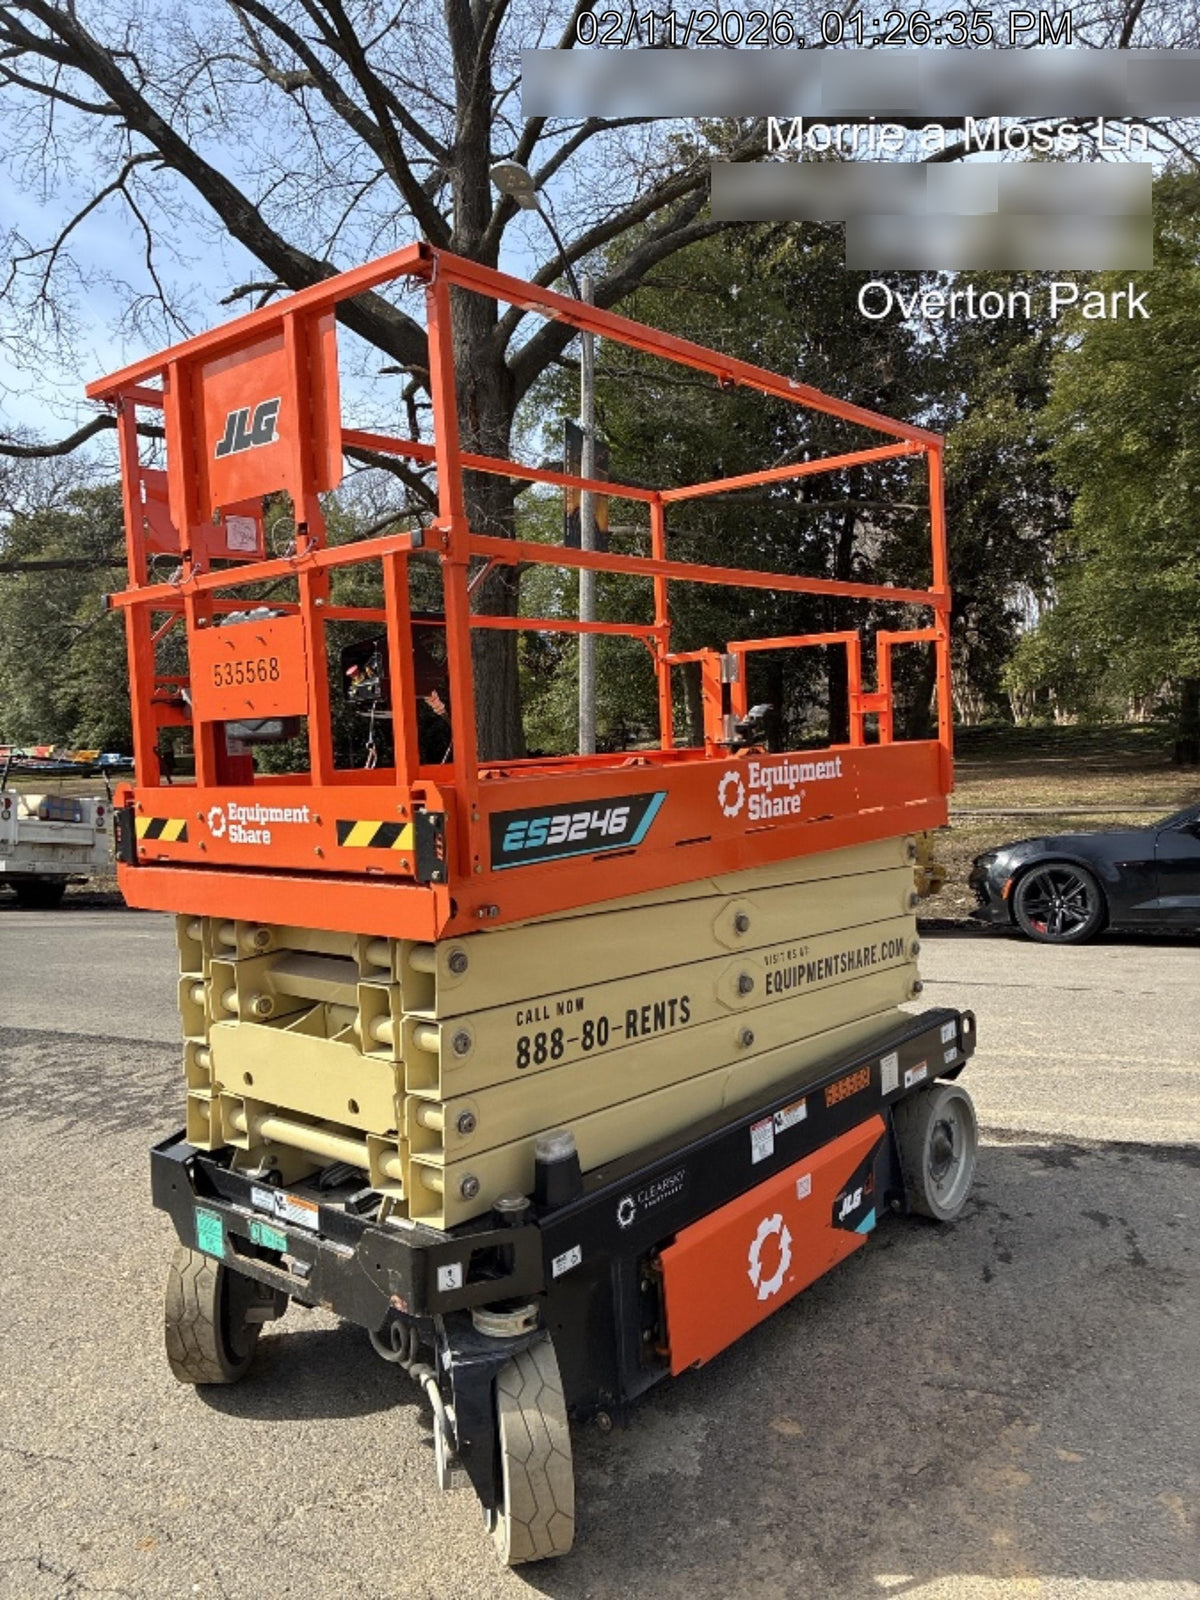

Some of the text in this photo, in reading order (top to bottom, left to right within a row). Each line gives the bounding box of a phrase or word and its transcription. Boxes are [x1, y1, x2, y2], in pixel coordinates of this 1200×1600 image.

[214, 396, 281, 459] JLG
[213, 657, 280, 687] 535568
[748, 755, 843, 792] Equipment
[227, 802, 310, 826] Equipment
[502, 806, 631, 852] ES3246
[228, 823, 271, 845] Share
[765, 937, 905, 997] EQUIPMENTSHARE.COM
[516, 997, 585, 1027] CALL NOW
[516, 994, 691, 1070] 888-80-RENTS
